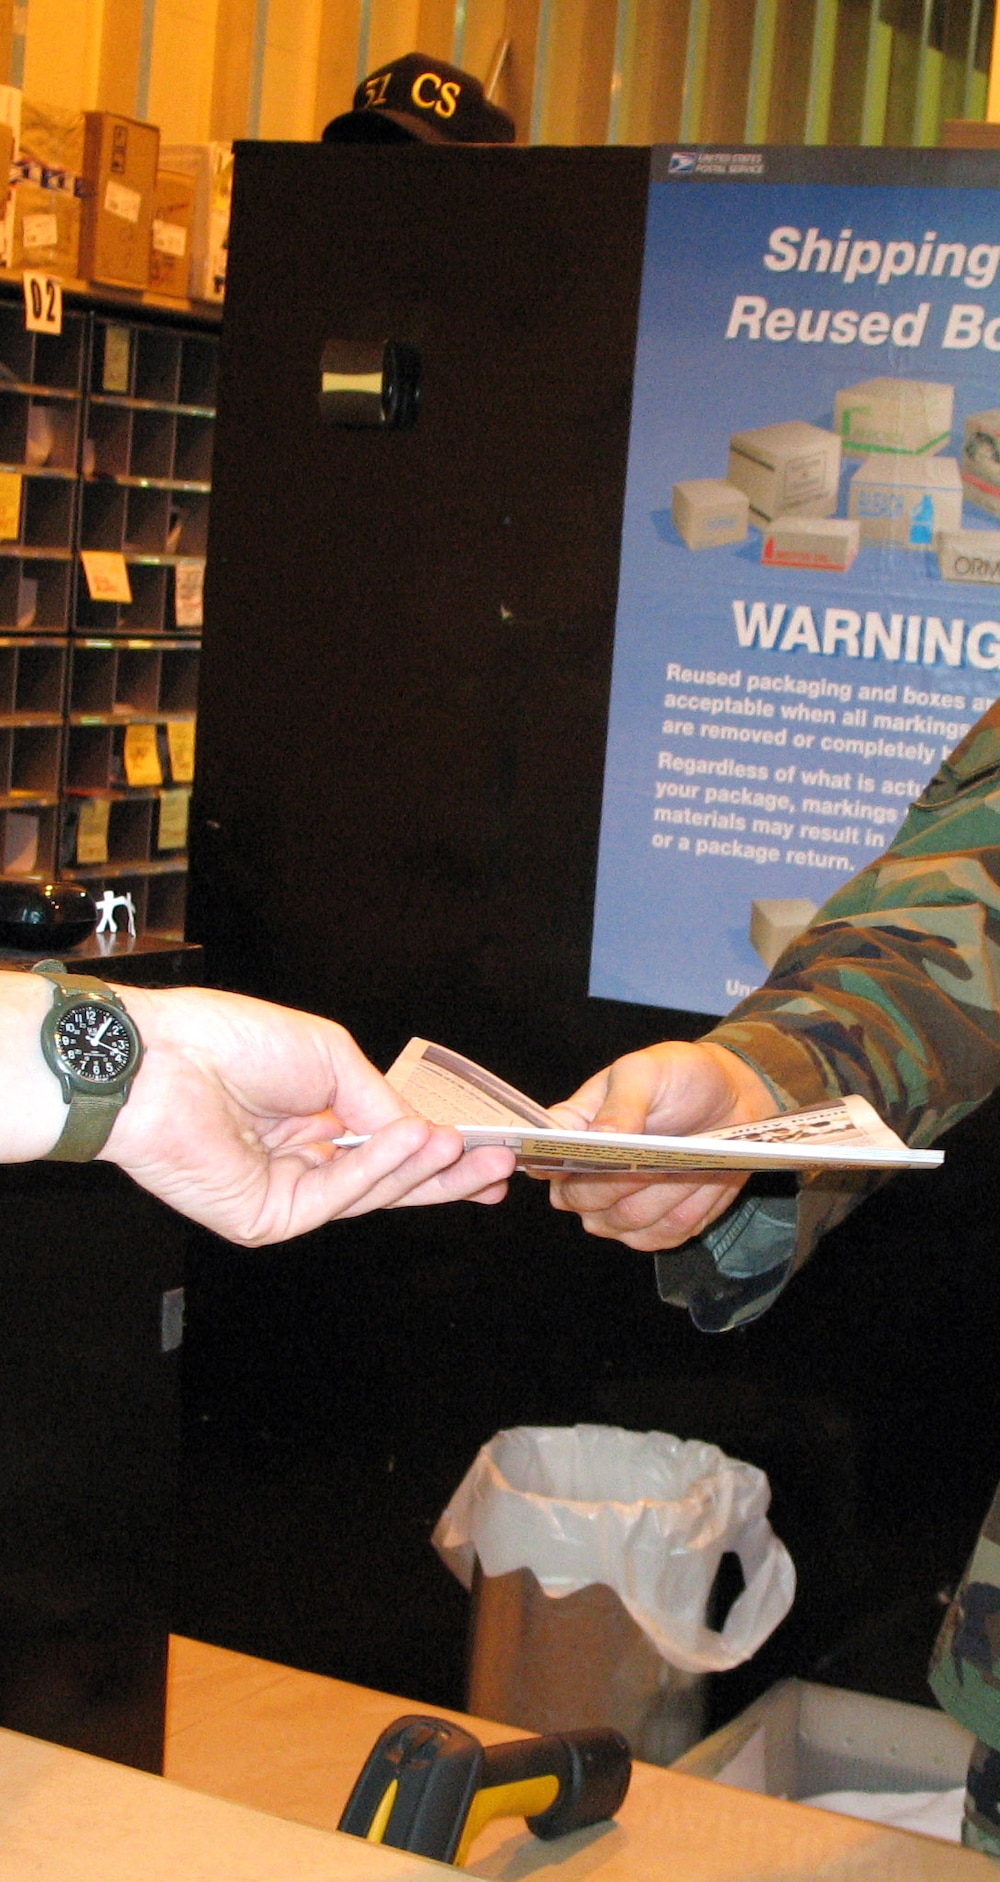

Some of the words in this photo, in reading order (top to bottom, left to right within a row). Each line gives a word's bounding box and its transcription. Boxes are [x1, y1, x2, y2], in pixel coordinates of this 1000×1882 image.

[411, 72, 461, 119] CS
[725, 295, 931, 347] Reused
[666, 662, 742, 688] Reused
[746, 674, 853, 703] packaging
[858, 685, 898, 704] and
[903, 686, 967, 711] boxes
[972, 696, 1000, 713] ar
[664, 693, 775, 716] acceptable
[781, 703, 837, 725] when
[842, 708, 869, 727] all
[873, 714, 973, 740] markings
[662, 719, 695, 736] are
[701, 722, 788, 747] removed
[793, 733, 815, 748] or
[820, 735, 936, 765] completely
[658, 751, 769, 781] Regardless
[774, 765, 797, 783] of
[801, 769, 852, 790] what
[857, 772, 876, 793] is
[655, 781, 700, 799] your
[704, 786, 796, 813] package,
[802, 798, 899, 824] markings
[654, 807, 747, 831] materials
[752, 819, 795, 840] may
[800, 825, 860, 845] result
[864, 828, 886, 847] in
[652, 833, 674, 849] or
[677, 836, 691, 852] a
[695, 839, 781, 864] package
[785, 848, 856, 872] return.
[86, 1010, 96, 1021] 12
[112, 1026, 120, 1036] 2
[68, 1049, 75, 1060] 8
[114, 1054, 122, 1063] 4
[117, 1040, 125, 1050] 3
[80, 1060, 87, 1070] 7
[93, 1065, 100, 1075] 6
[106, 1062, 113, 1072] 5
